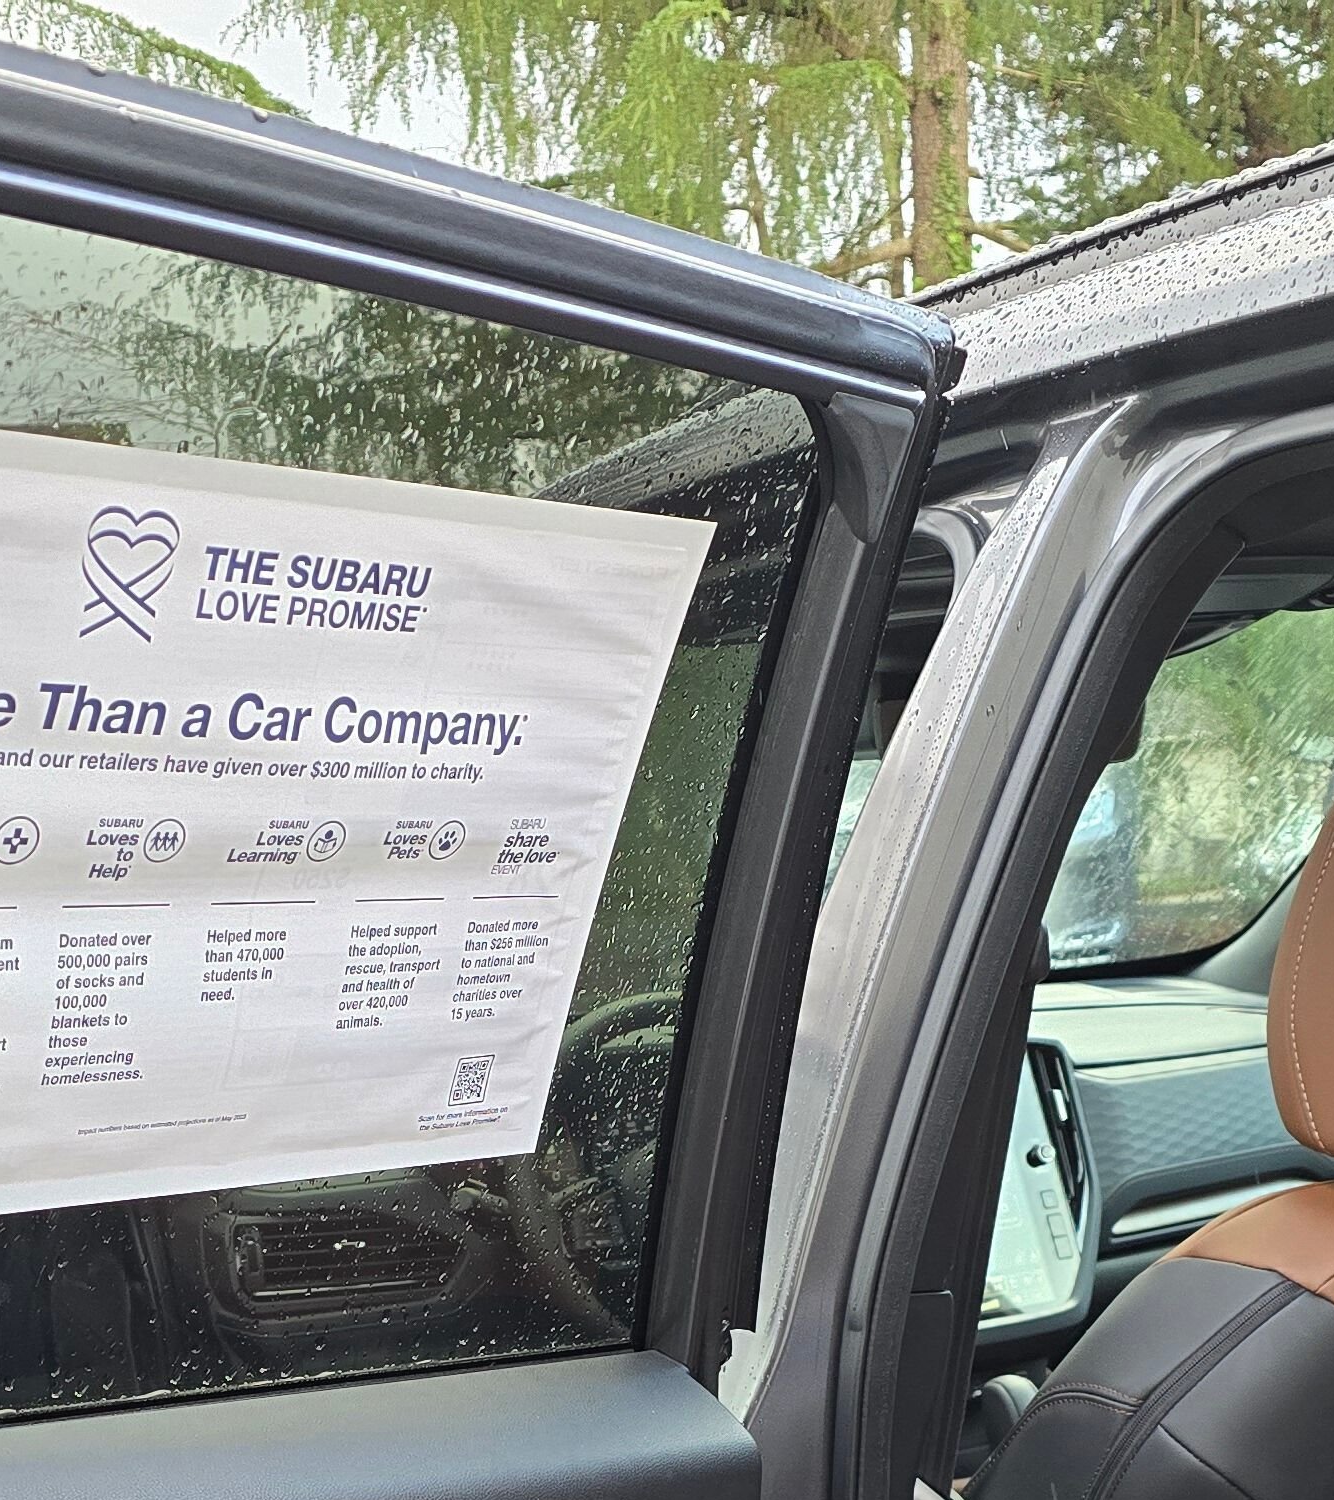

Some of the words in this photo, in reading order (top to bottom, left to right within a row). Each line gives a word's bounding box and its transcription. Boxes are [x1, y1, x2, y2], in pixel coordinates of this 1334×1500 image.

[204, 545, 280, 587] THE
[286, 554, 433, 599] SUBARU
[195, 587, 281, 625] LOVE
[39, 682, 167, 736] Than
[180, 703, 212, 739] a
[228, 692, 313, 742] Car
[38, 753, 75, 769] our
[78, 752, 159, 772] retailers
[162, 754, 209, 774] have
[211, 756, 263, 779] given
[267, 763, 308, 778] over
[309, 759, 351, 781] $300
[353, 761, 408, 780] million
[411, 762, 427, 780] to
[430, 762, 484, 785] charity.
[98, 817, 145, 829] SUBARU
[268, 819, 310, 830] SUBARU
[395, 820, 434, 830] SUBARU
[85, 829, 140, 847] Loves
[255, 830, 305, 847] Loves
[382, 830, 428, 846] Loves
[503, 830, 550, 848] share
[116, 847, 134, 862] to
[226, 847, 302, 865] Learning
[386, 845, 425, 860] Pets
[490, 863, 523, 875] EVENT
[350, 924, 392, 942] Helped
[393, 923, 438, 940] support
[467, 919, 511, 934] Donated
[511, 920, 539, 932] more
[59, 932, 118, 949] Donated
[121, 934, 153, 946] over
[206, 928, 252, 947] Helped
[254, 930, 287, 942] more
[464, 938, 488, 952] than
[489, 936, 514, 951] $256
[514, 934, 549, 949] million
[204, 949, 233, 964] than
[236, 947, 285, 964] 470,000
[348, 943, 367, 958] the
[369, 941, 422, 959] adoption,
[57, 953, 111, 972] 500,000
[114, 951, 148, 971] pairs
[344, 963, 387, 976] rescue,
[389, 958, 441, 975] transport
[460, 957, 472, 969] to
[473, 953, 516, 969] national
[516, 951, 536, 966] and
[55, 975, 72, 990] of
[73, 973, 115, 989] socks
[118, 971, 145, 987] and
[202, 967, 258, 983] students
[260, 966, 273, 980] in
[456, 972, 511, 986] hometown
[200, 986, 235, 1002] need.
[341, 979, 365, 994] and
[365, 977, 401, 992] health
[402, 976, 416, 990] of
[54, 993, 108, 1012] 100,000
[338, 999, 365, 1012] over
[365, 994, 409, 1011] 420,000
[452, 988, 497, 1003] charities
[499, 988, 524, 1000] over
[50, 1013, 111, 1030] blankets
[114, 1012, 128, 1026] to
[335, 1014, 383, 1030] animals.
[451, 1007, 464, 1021] 15
[464, 1007, 496, 1023] years.
[48, 1034, 88, 1049] those
[44, 1050, 134, 1071] experiencing
[40, 1069, 144, 1086] homelessness.
